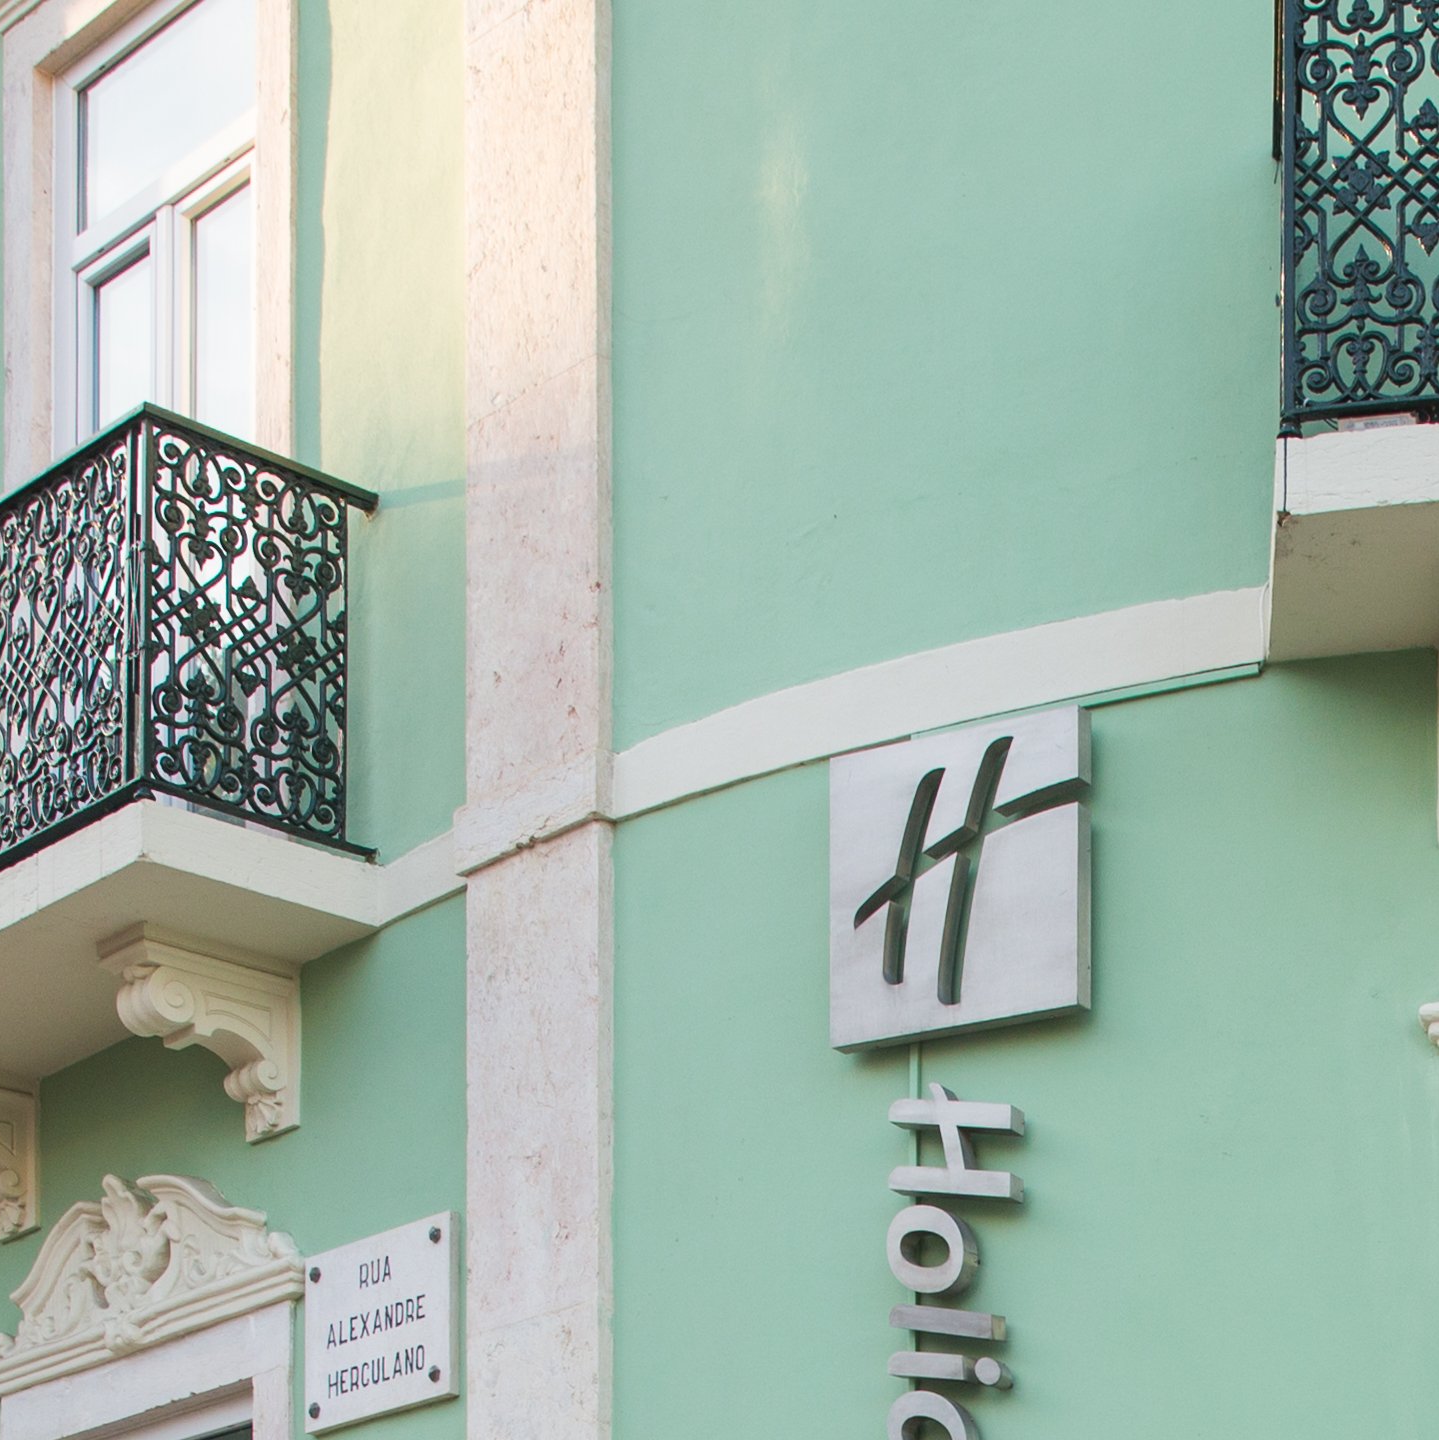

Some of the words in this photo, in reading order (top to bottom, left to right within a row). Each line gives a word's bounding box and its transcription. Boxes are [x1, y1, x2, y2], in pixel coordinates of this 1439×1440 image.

[359, 1255, 392, 1289] RUA
[326, 1294, 426, 1350] ALEXANDRE
[327, 1344, 426, 1399] HERCULANO
